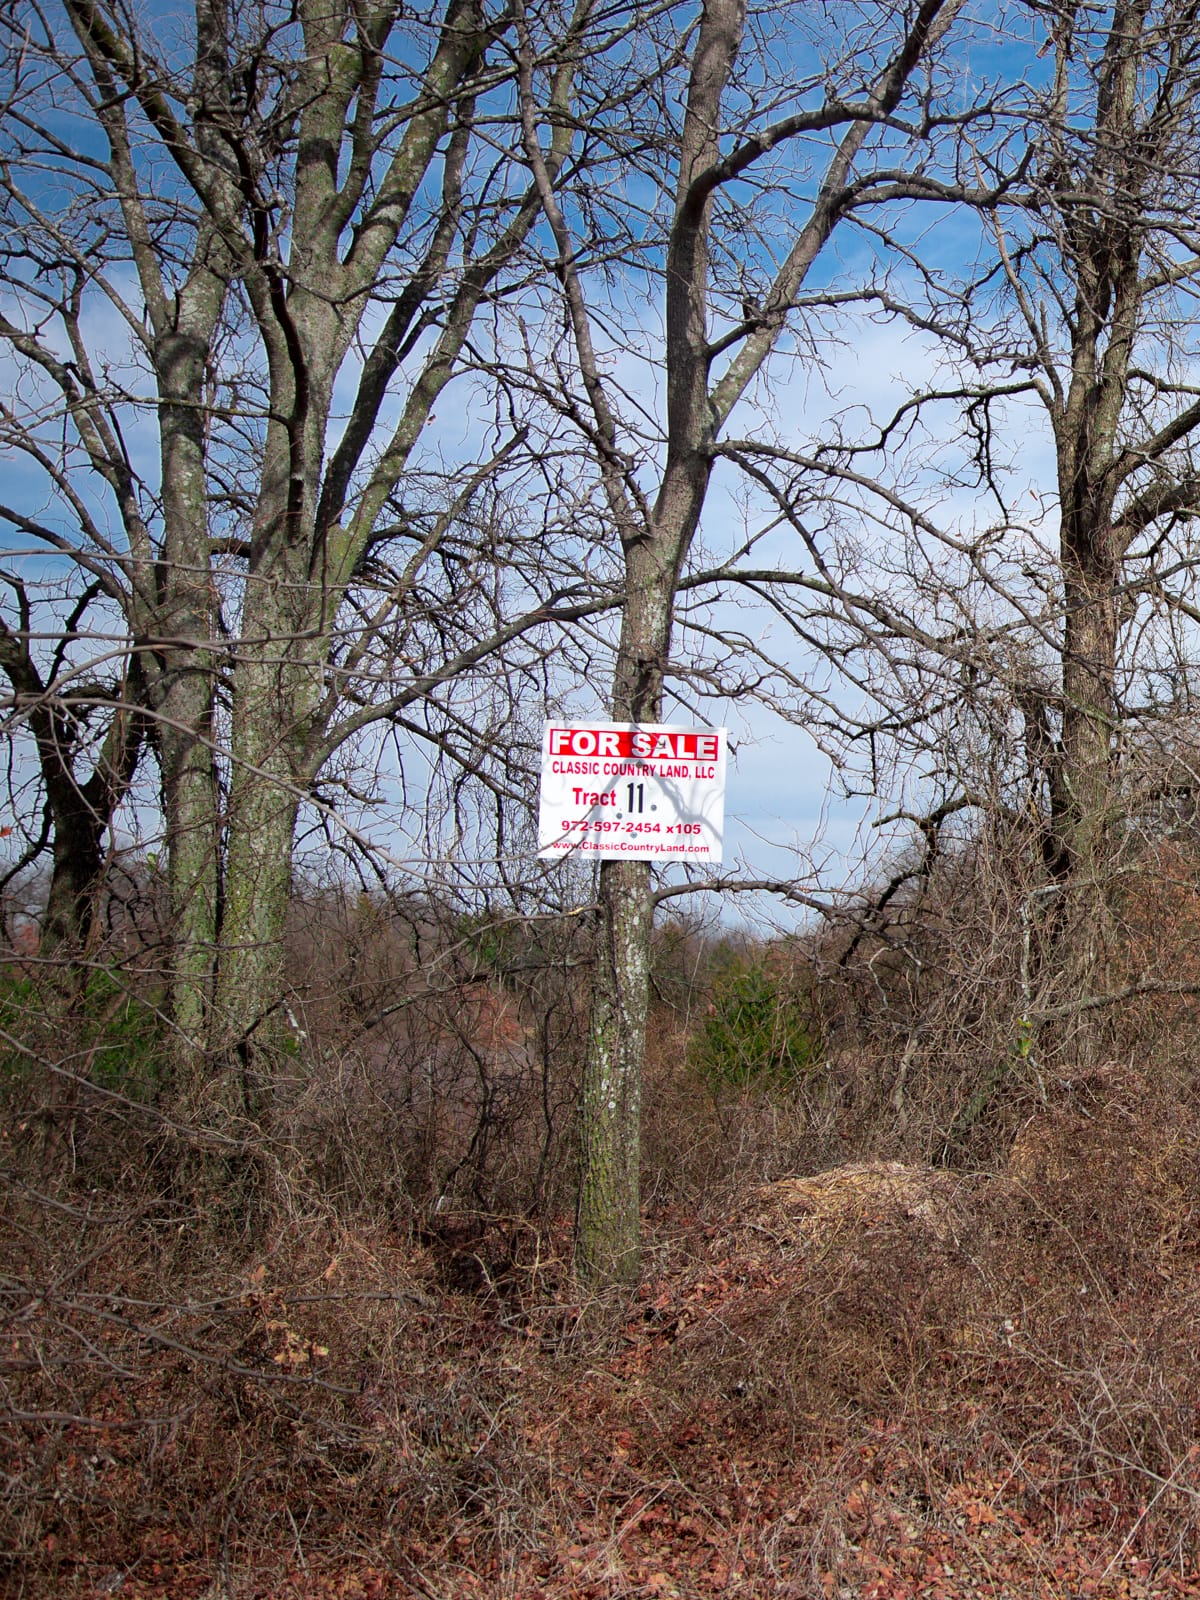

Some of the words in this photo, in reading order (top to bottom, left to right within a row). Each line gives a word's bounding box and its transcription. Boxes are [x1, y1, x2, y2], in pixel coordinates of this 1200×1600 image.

[551, 731, 620, 756] FOR
[631, 733, 717, 760] SALE
[552, 761, 600, 775] CLASSIC
[603, 763, 656, 777] COUNTRY
[659, 764, 692, 780] LAND,
[695, 766, 715, 779] LLC
[572, 787, 617, 807] Tract
[626, 782, 644, 814] 11
[561, 820, 660, 834] 972-597-2454
[666, 823, 701, 835] x105
[553, 840, 709, 854] www.ClassicCountryLand.com
